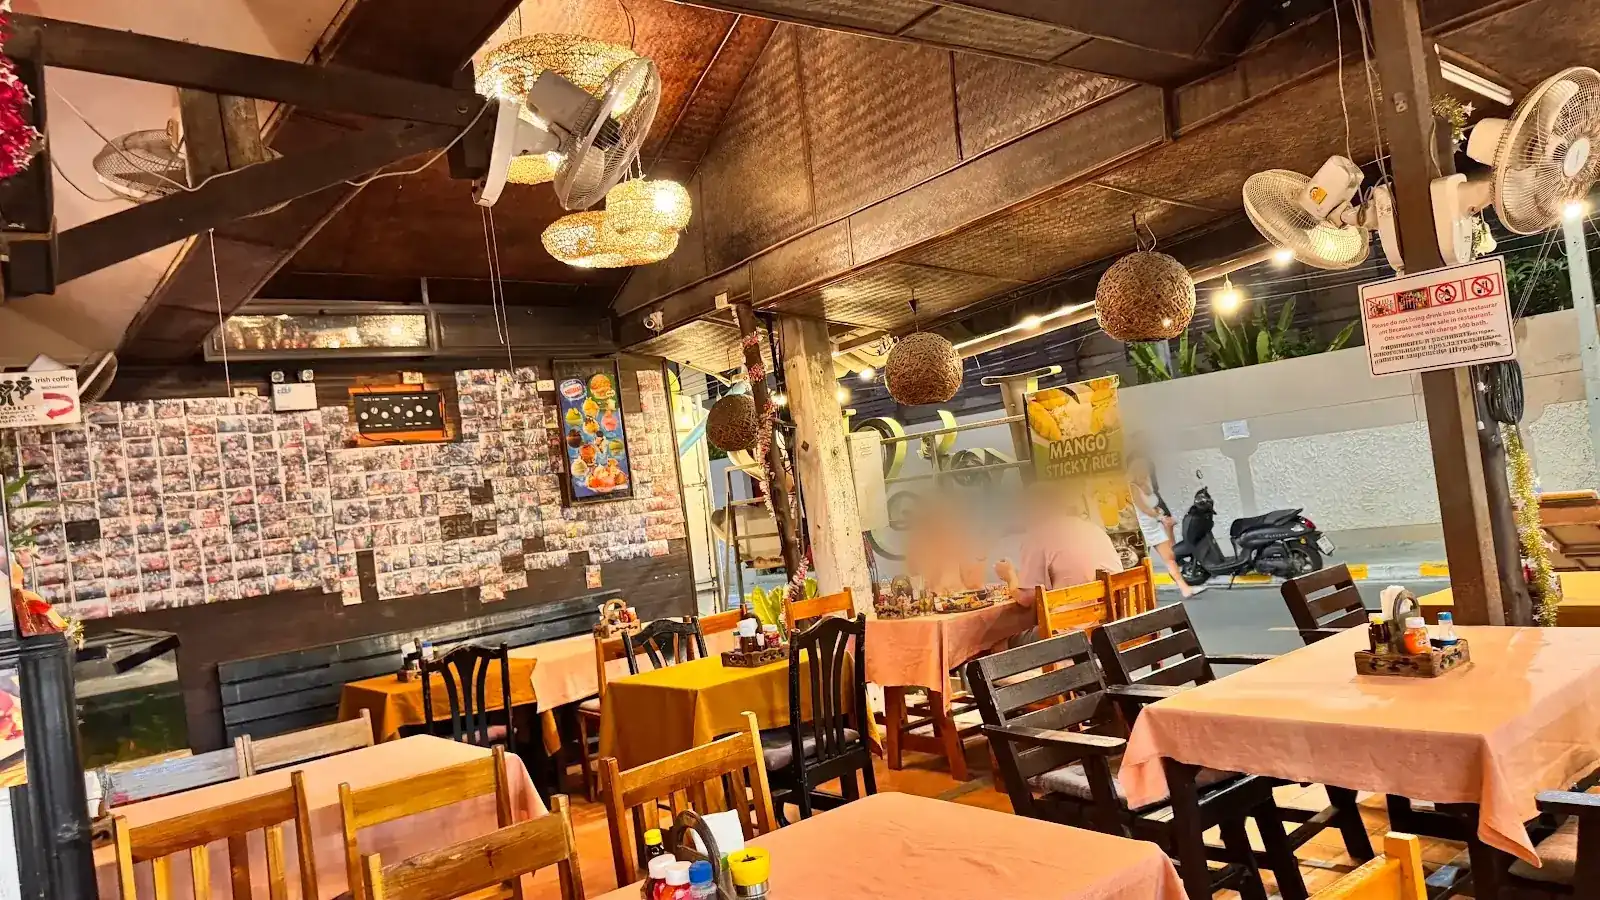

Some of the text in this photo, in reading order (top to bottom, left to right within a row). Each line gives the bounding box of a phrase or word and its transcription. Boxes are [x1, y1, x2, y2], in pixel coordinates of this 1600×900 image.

[1372, 321, 1389, 329] Please
[1408, 314, 1424, 323] bring
[1425, 311, 1441, 319] drink
[1436, 324, 1457, 333] charge
[1050, 434, 1107, 460] MANGO
[1046, 451, 1119, 477] STICKY RICE
